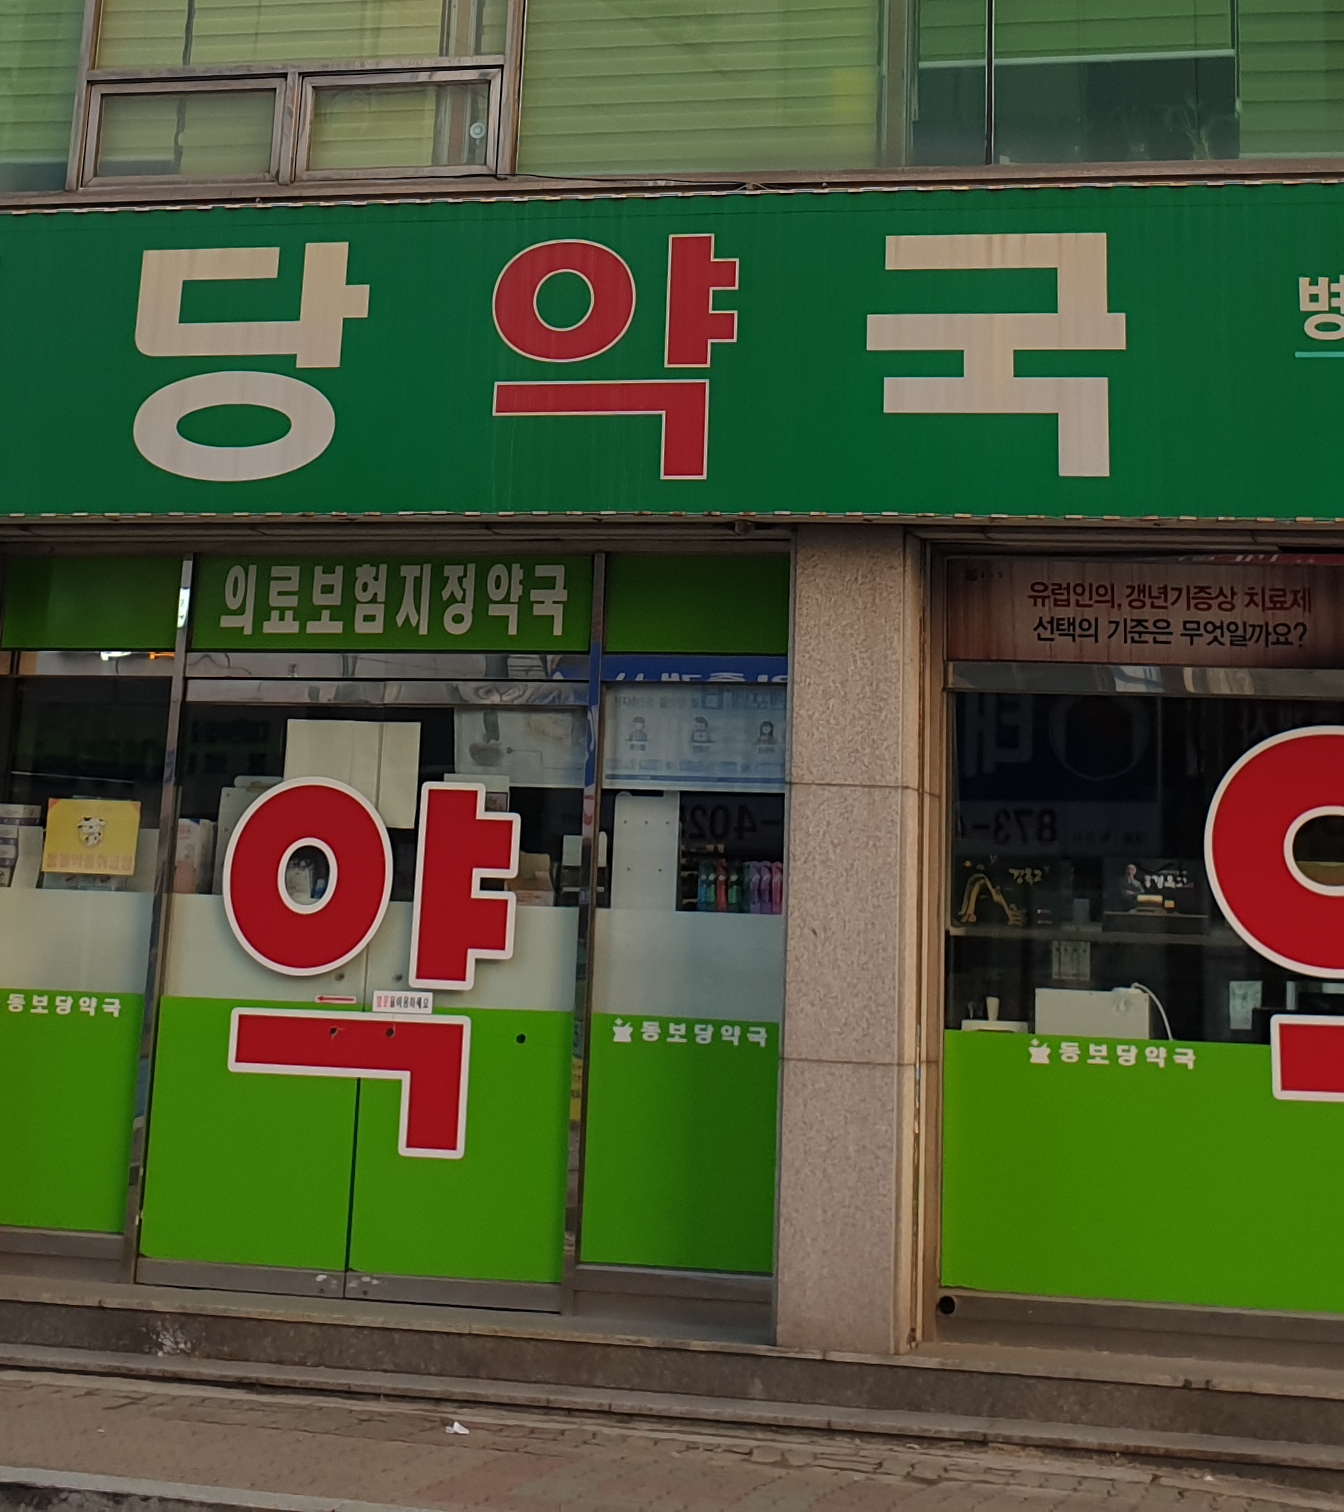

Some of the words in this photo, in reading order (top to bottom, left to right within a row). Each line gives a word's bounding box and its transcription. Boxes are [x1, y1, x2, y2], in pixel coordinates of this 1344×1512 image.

[219, 562, 570, 636] 의료보험지정약국
[1126, 584, 1238, 612] 갱년기증상
[1244, 586, 1312, 614] 치료제
[1033, 616, 1100, 644] 선택의
[1107, 618, 1173, 644] 기준은
[1180, 620, 1308, 648] 무엇일까요?
[222, 775, 522, 1159] 약
[6, 990, 122, 1019] 동보당약국
[640, 1019, 768, 1048] 동보당약국
[1058, 1039, 1197, 1071] 동보당약국
